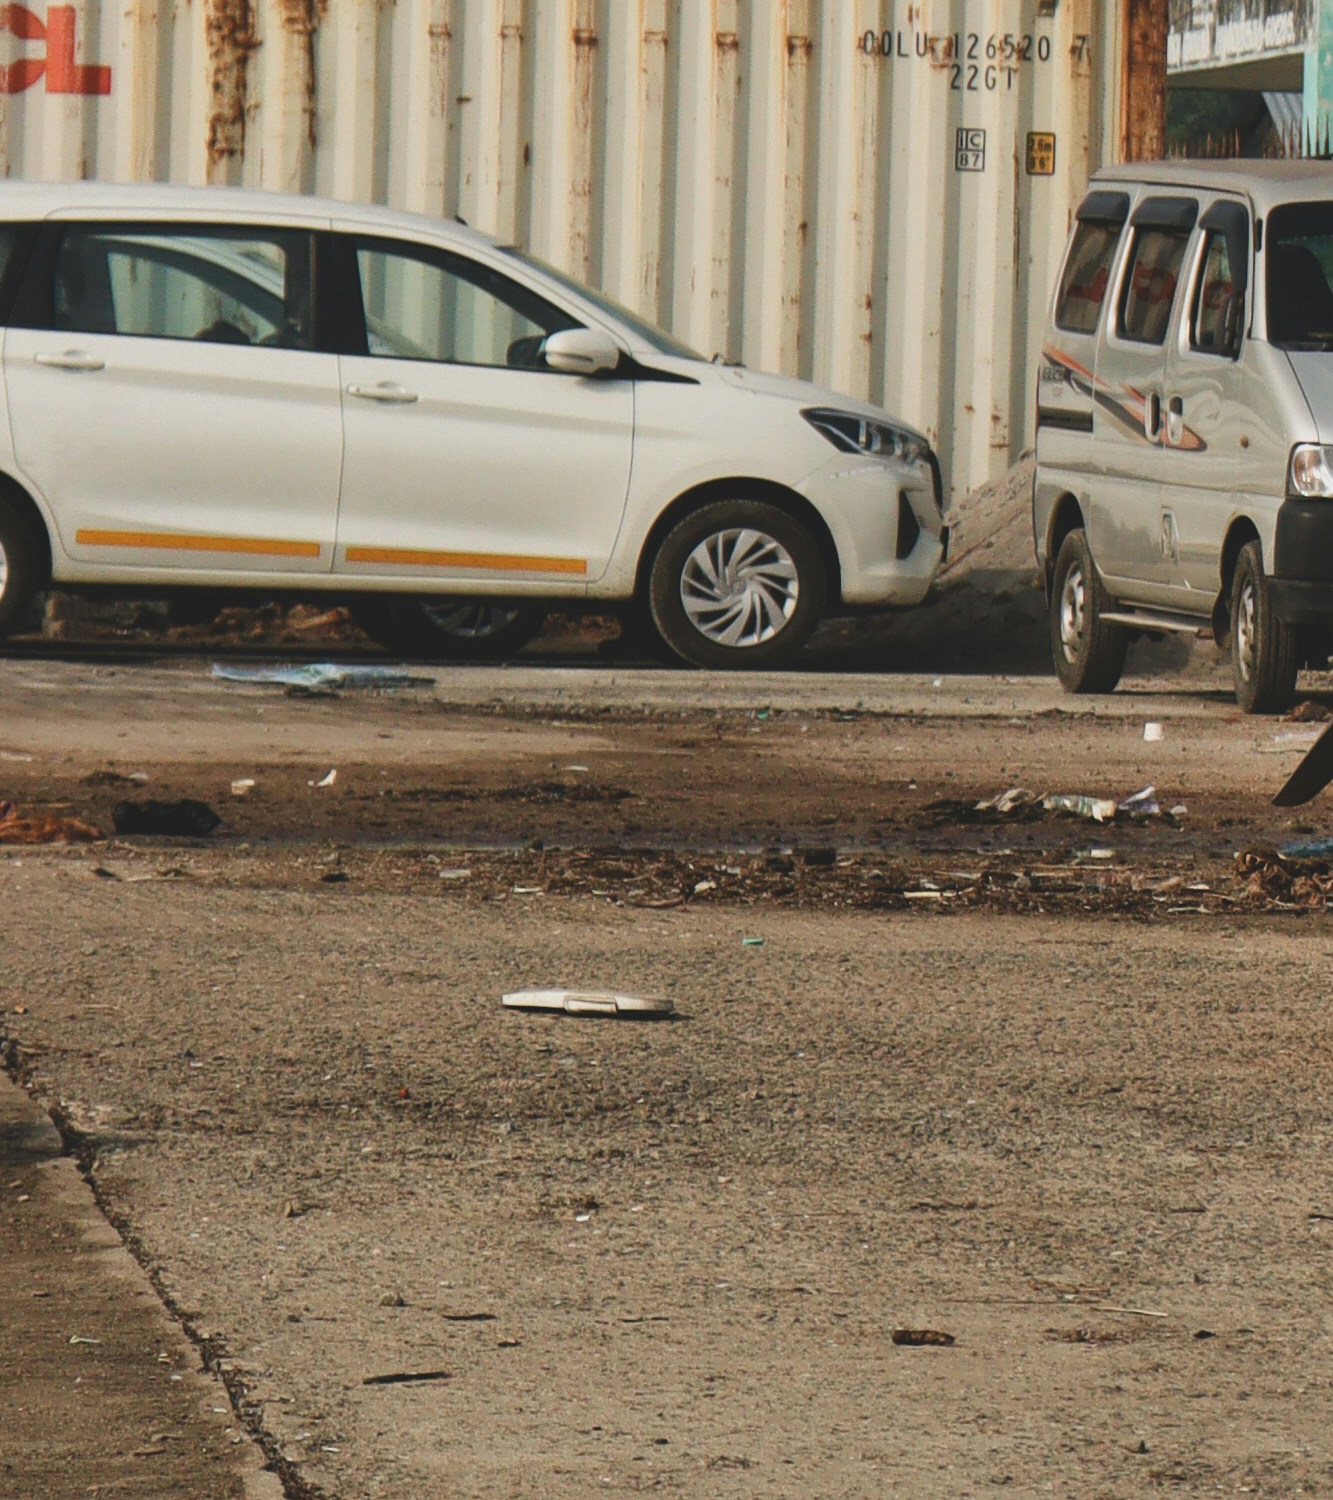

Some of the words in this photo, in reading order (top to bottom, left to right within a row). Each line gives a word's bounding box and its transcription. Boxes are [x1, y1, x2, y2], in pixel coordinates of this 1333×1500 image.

[953, 33, 1050, 62] 126520
[1075, 35, 1087, 62] 7
[960, 152, 980, 167] 87
